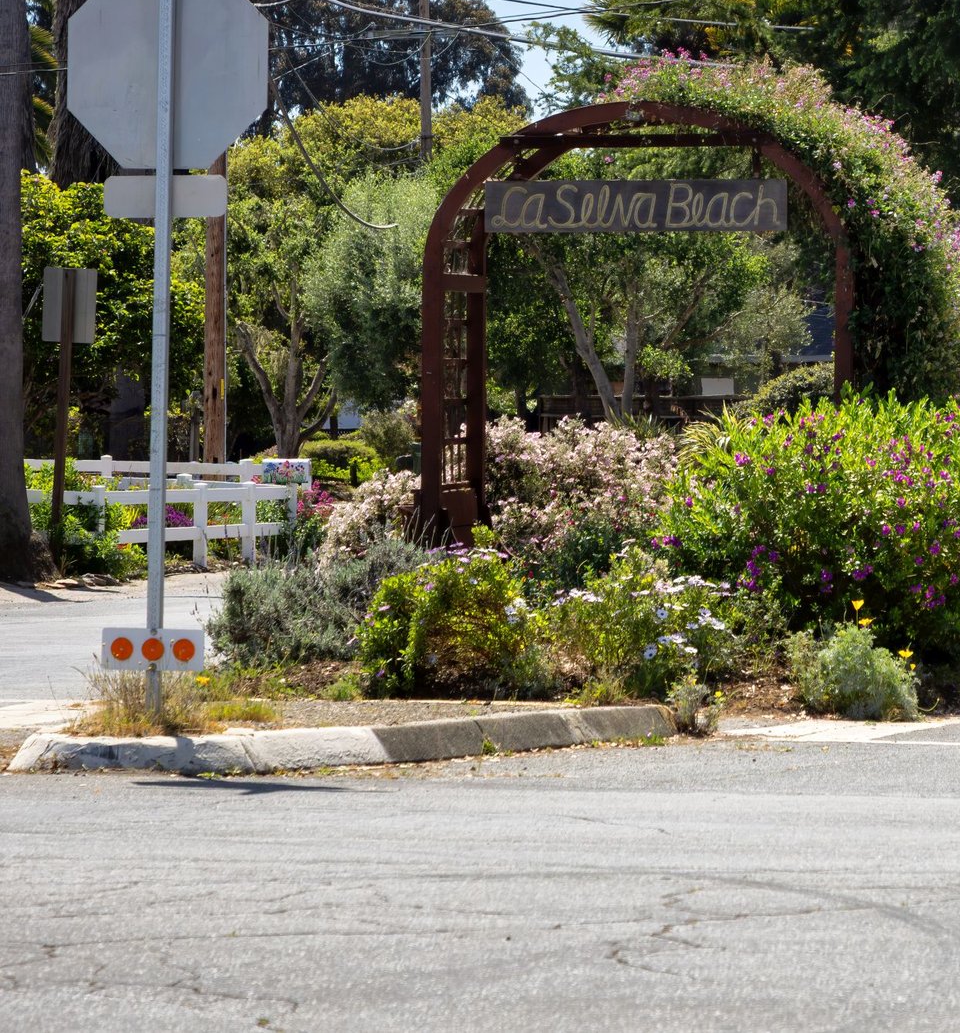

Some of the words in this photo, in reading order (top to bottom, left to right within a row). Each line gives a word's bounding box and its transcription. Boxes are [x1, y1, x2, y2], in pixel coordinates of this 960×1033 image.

[490, 185, 548, 229] La
[547, 183, 658, 229] Selva
[664, 182, 780, 228] Beach
